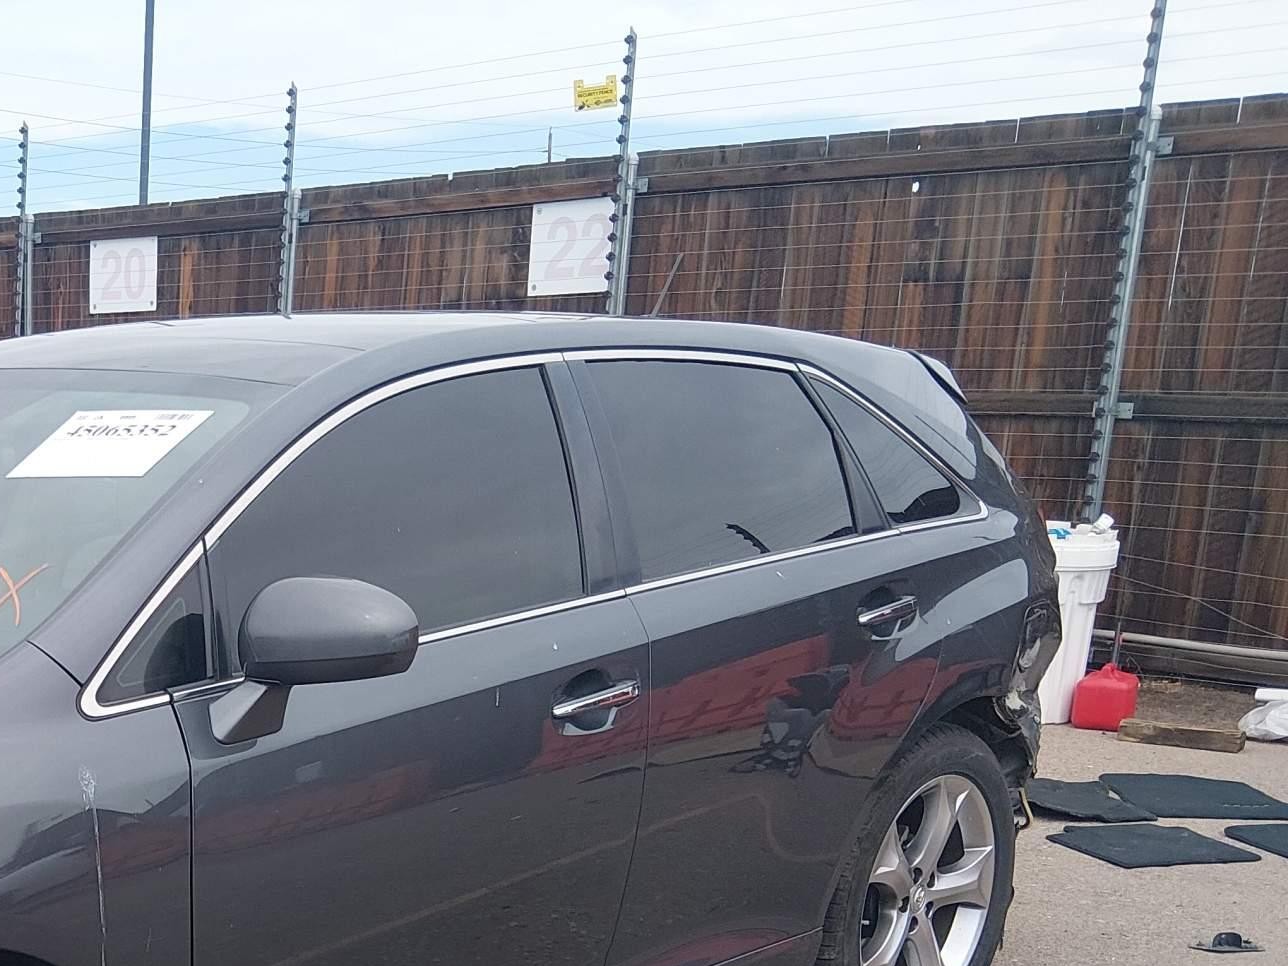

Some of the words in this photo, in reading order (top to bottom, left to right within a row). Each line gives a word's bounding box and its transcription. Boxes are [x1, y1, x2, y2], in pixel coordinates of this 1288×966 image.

[544, 213, 613, 280] 22
[101, 247, 146, 303] 20
[66, 423, 177, 438] 45065352
